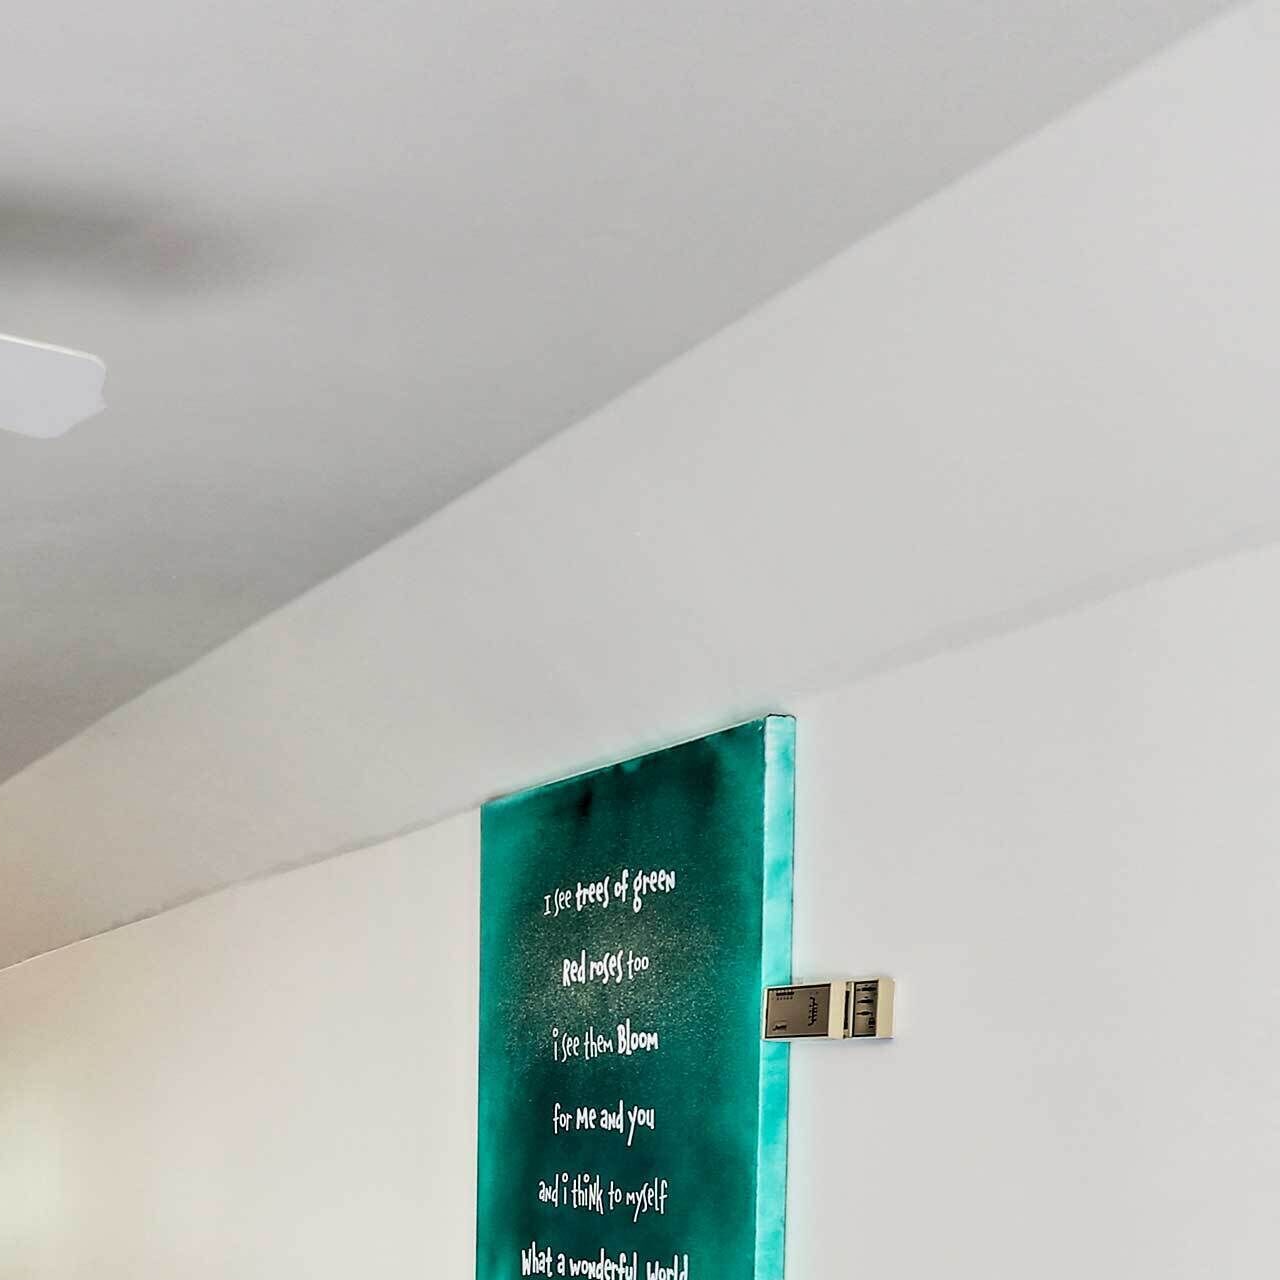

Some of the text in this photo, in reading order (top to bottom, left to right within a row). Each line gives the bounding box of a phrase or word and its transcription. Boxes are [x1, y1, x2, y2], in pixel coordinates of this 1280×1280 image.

[543, 894, 552, 916] I
[575, 875, 610, 912] trees
[614, 868, 629, 902] of
[632, 869, 676, 913] green
[562, 949, 649, 987] Red roses too
[552, 1027, 559, 1061] i
[583, 1025, 614, 1060] them
[552, 1102, 573, 1135] for
[627, 1105, 655, 1147] you
[561, 1172, 569, 1205] i
[571, 1173, 604, 1215] think
[608, 1180, 622, 1211] to
[625, 1176, 668, 1223] myself
[556, 1252, 566, 1277] a
